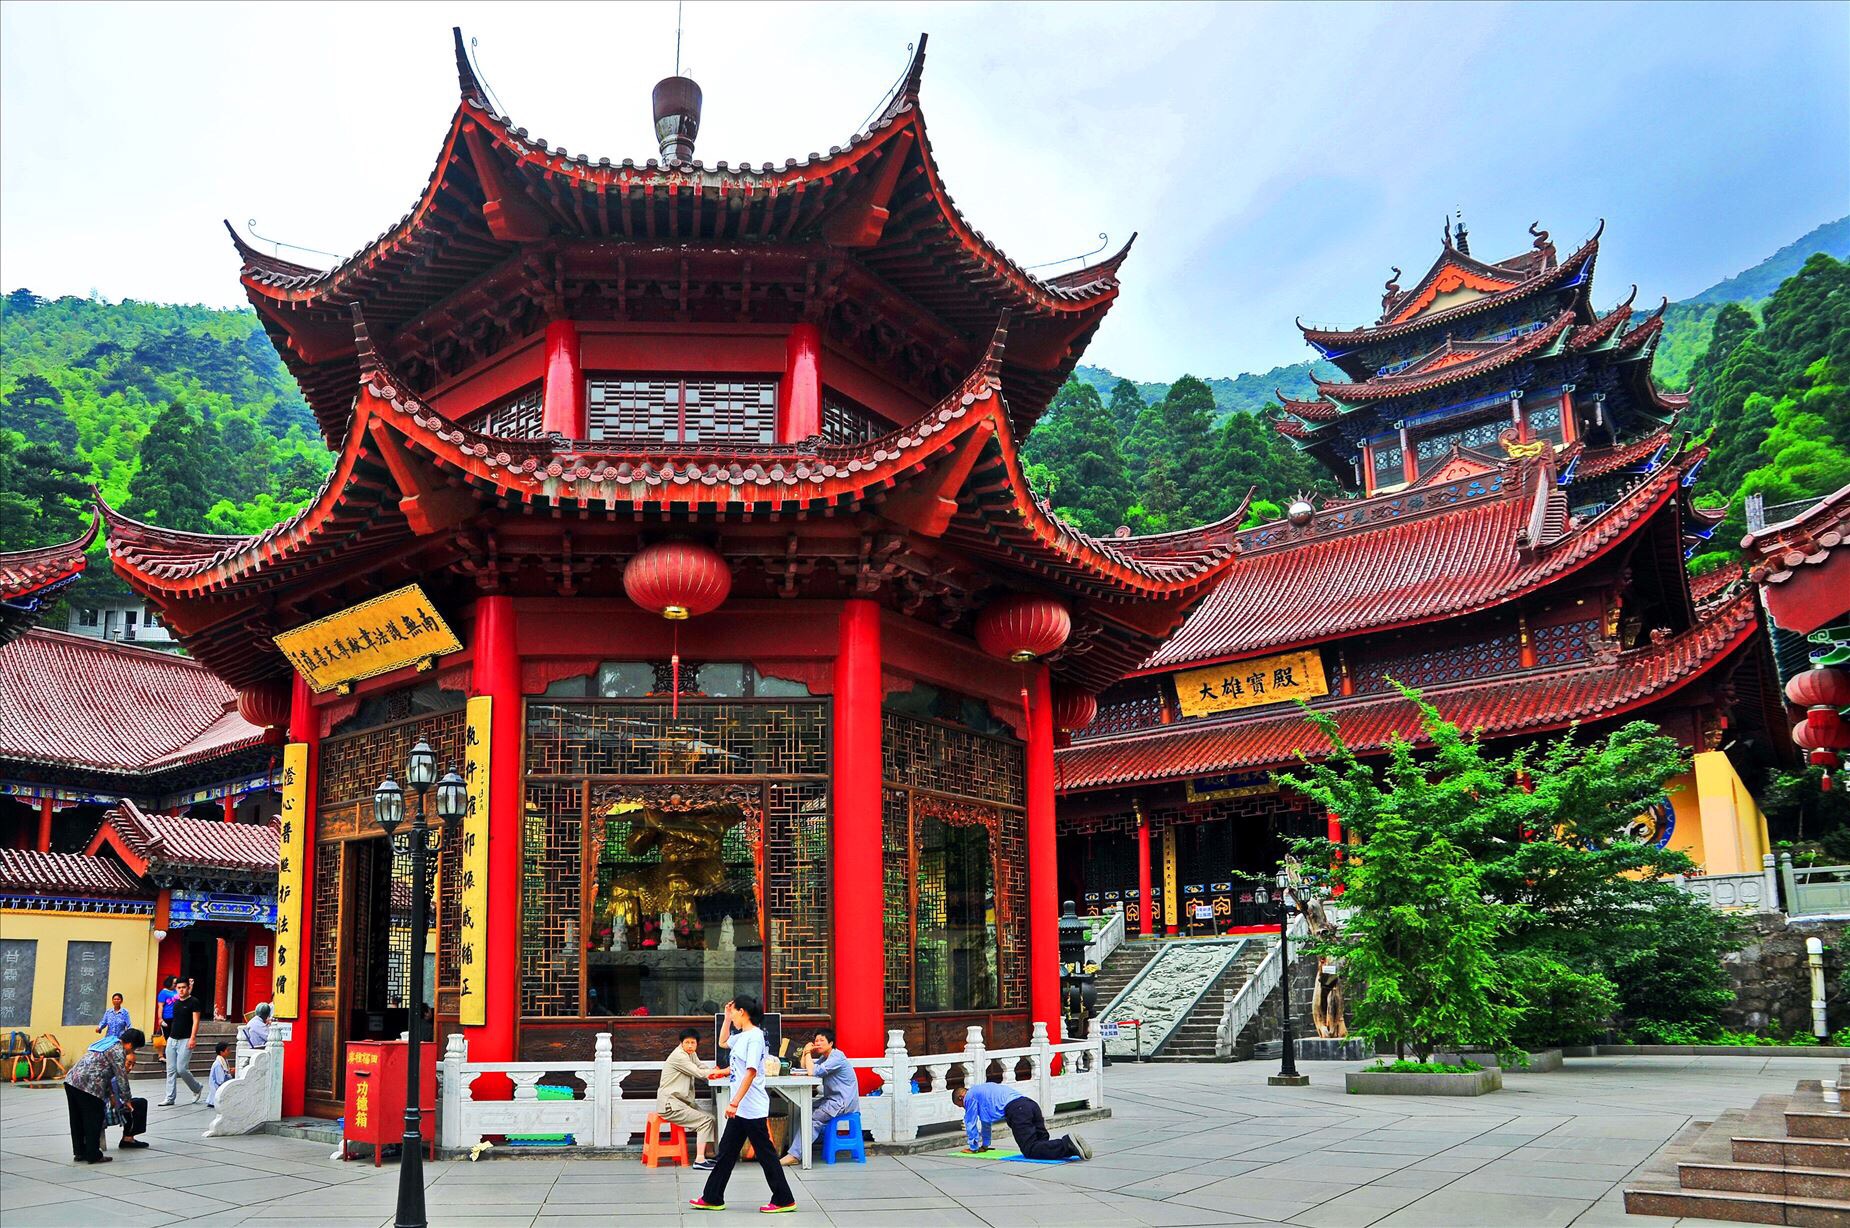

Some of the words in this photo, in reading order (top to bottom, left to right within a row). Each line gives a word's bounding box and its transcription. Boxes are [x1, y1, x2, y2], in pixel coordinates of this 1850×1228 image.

[1199, 666, 1300, 701] 大雄寶殿
[355, 1081, 369, 1128] 功德箱
